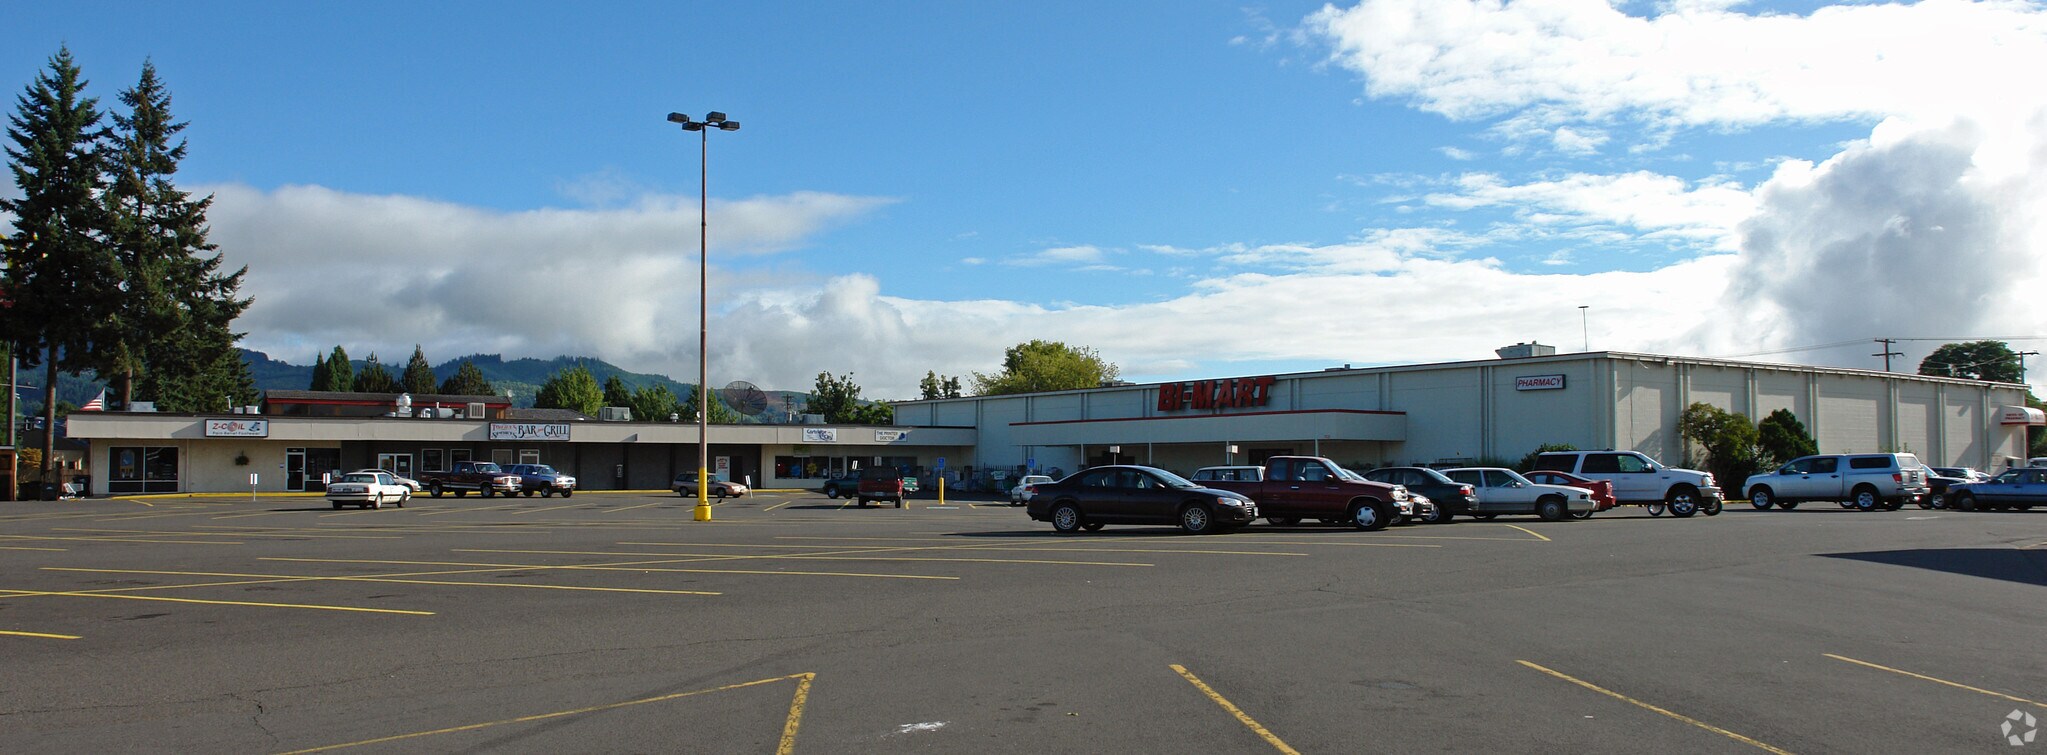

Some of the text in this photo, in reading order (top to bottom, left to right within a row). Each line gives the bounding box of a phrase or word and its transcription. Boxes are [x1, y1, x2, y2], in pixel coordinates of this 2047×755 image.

[1518, 377, 1561, 388] PHARMACY
[1158, 377, 1276, 411] BI-MART
[518, 424, 539, 438] BAR
[544, 424, 568, 438] GRILL
